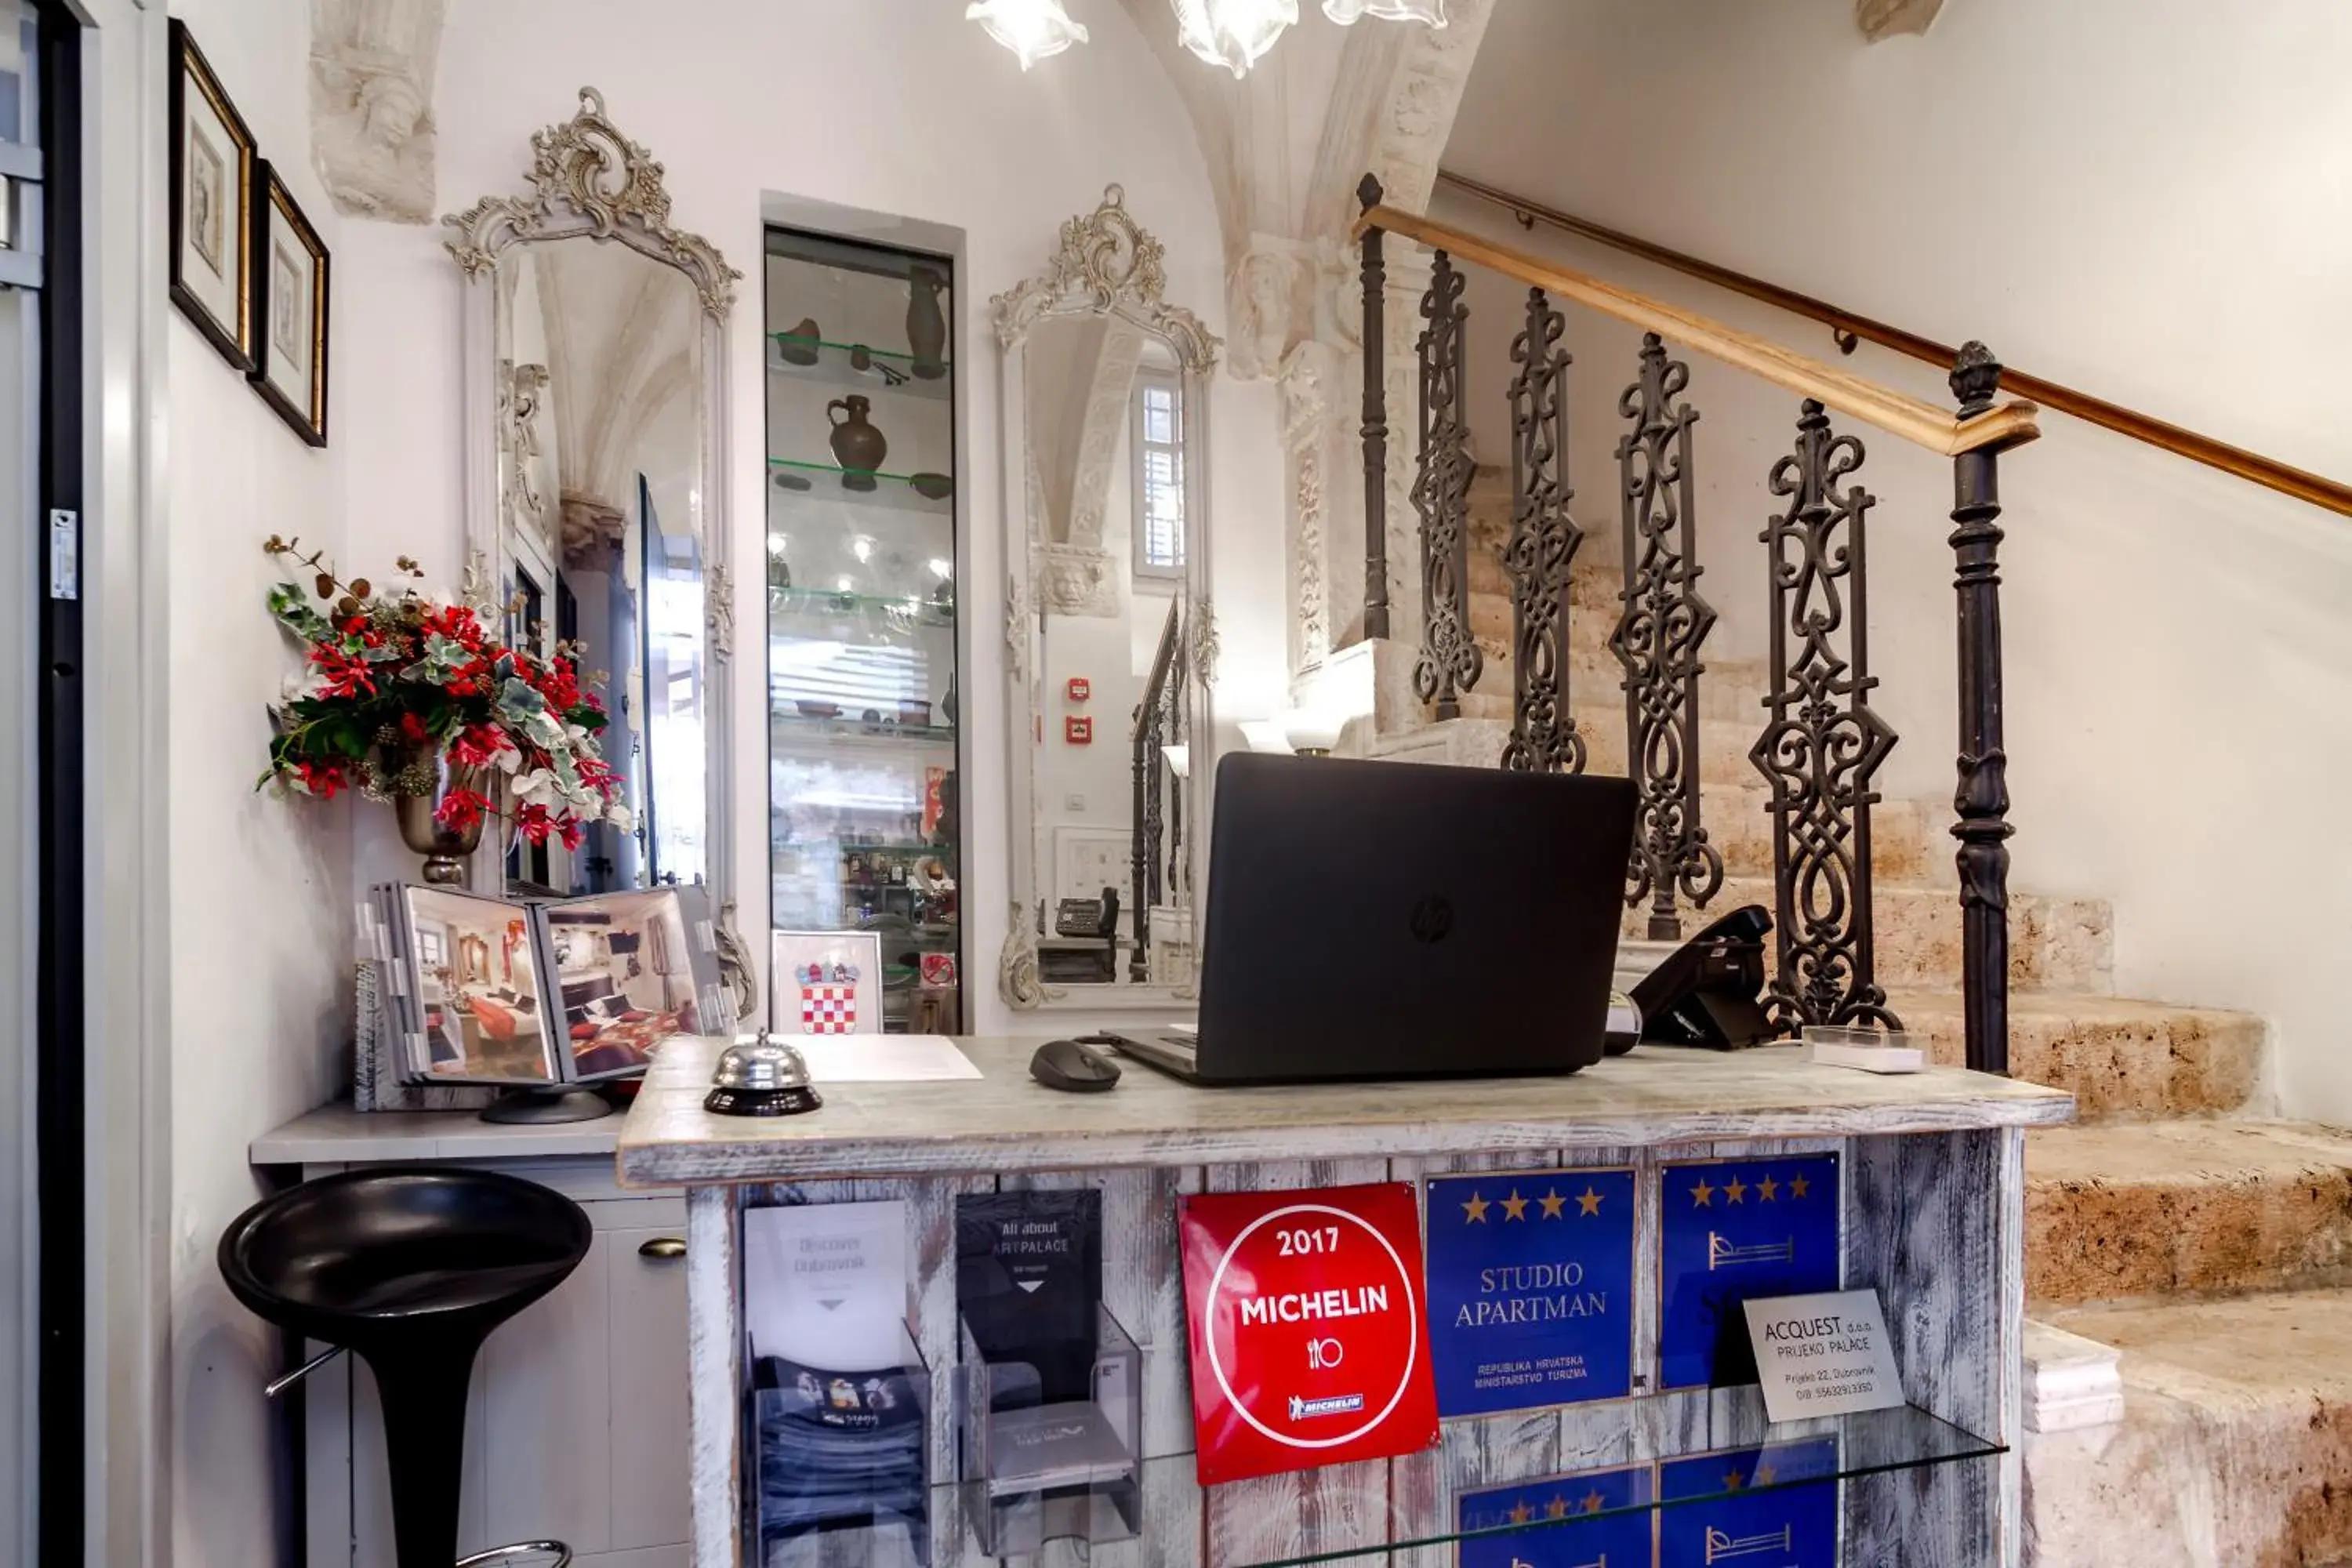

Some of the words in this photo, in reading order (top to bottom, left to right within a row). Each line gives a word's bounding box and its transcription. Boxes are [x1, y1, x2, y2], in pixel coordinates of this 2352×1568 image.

[1003, 1222, 1018, 1236] All
[1022, 1221, 1058, 1235] about
[1276, 1226, 1339, 1257] 2017
[1481, 1262, 1584, 1293] STUDIO
[1240, 1284, 1388, 1326] MICHELIN
[1454, 1291, 1607, 1327] APARTMAN
[1766, 1316, 1841, 1341] ACQUEST
[1777, 1341, 1825, 1359] PRIJEKO
[1829, 1337, 1871, 1353] PALACE
[1478, 1360, 1532, 1376] REPUBLIKA
[1536, 1355, 1584, 1370] HRVATSKA
[1475, 1372, 1543, 1389] MINISTARSTVO
[1547, 1367, 1588, 1381] TURIZMA
[1305, 1397, 1361, 1412] MICHELIN
